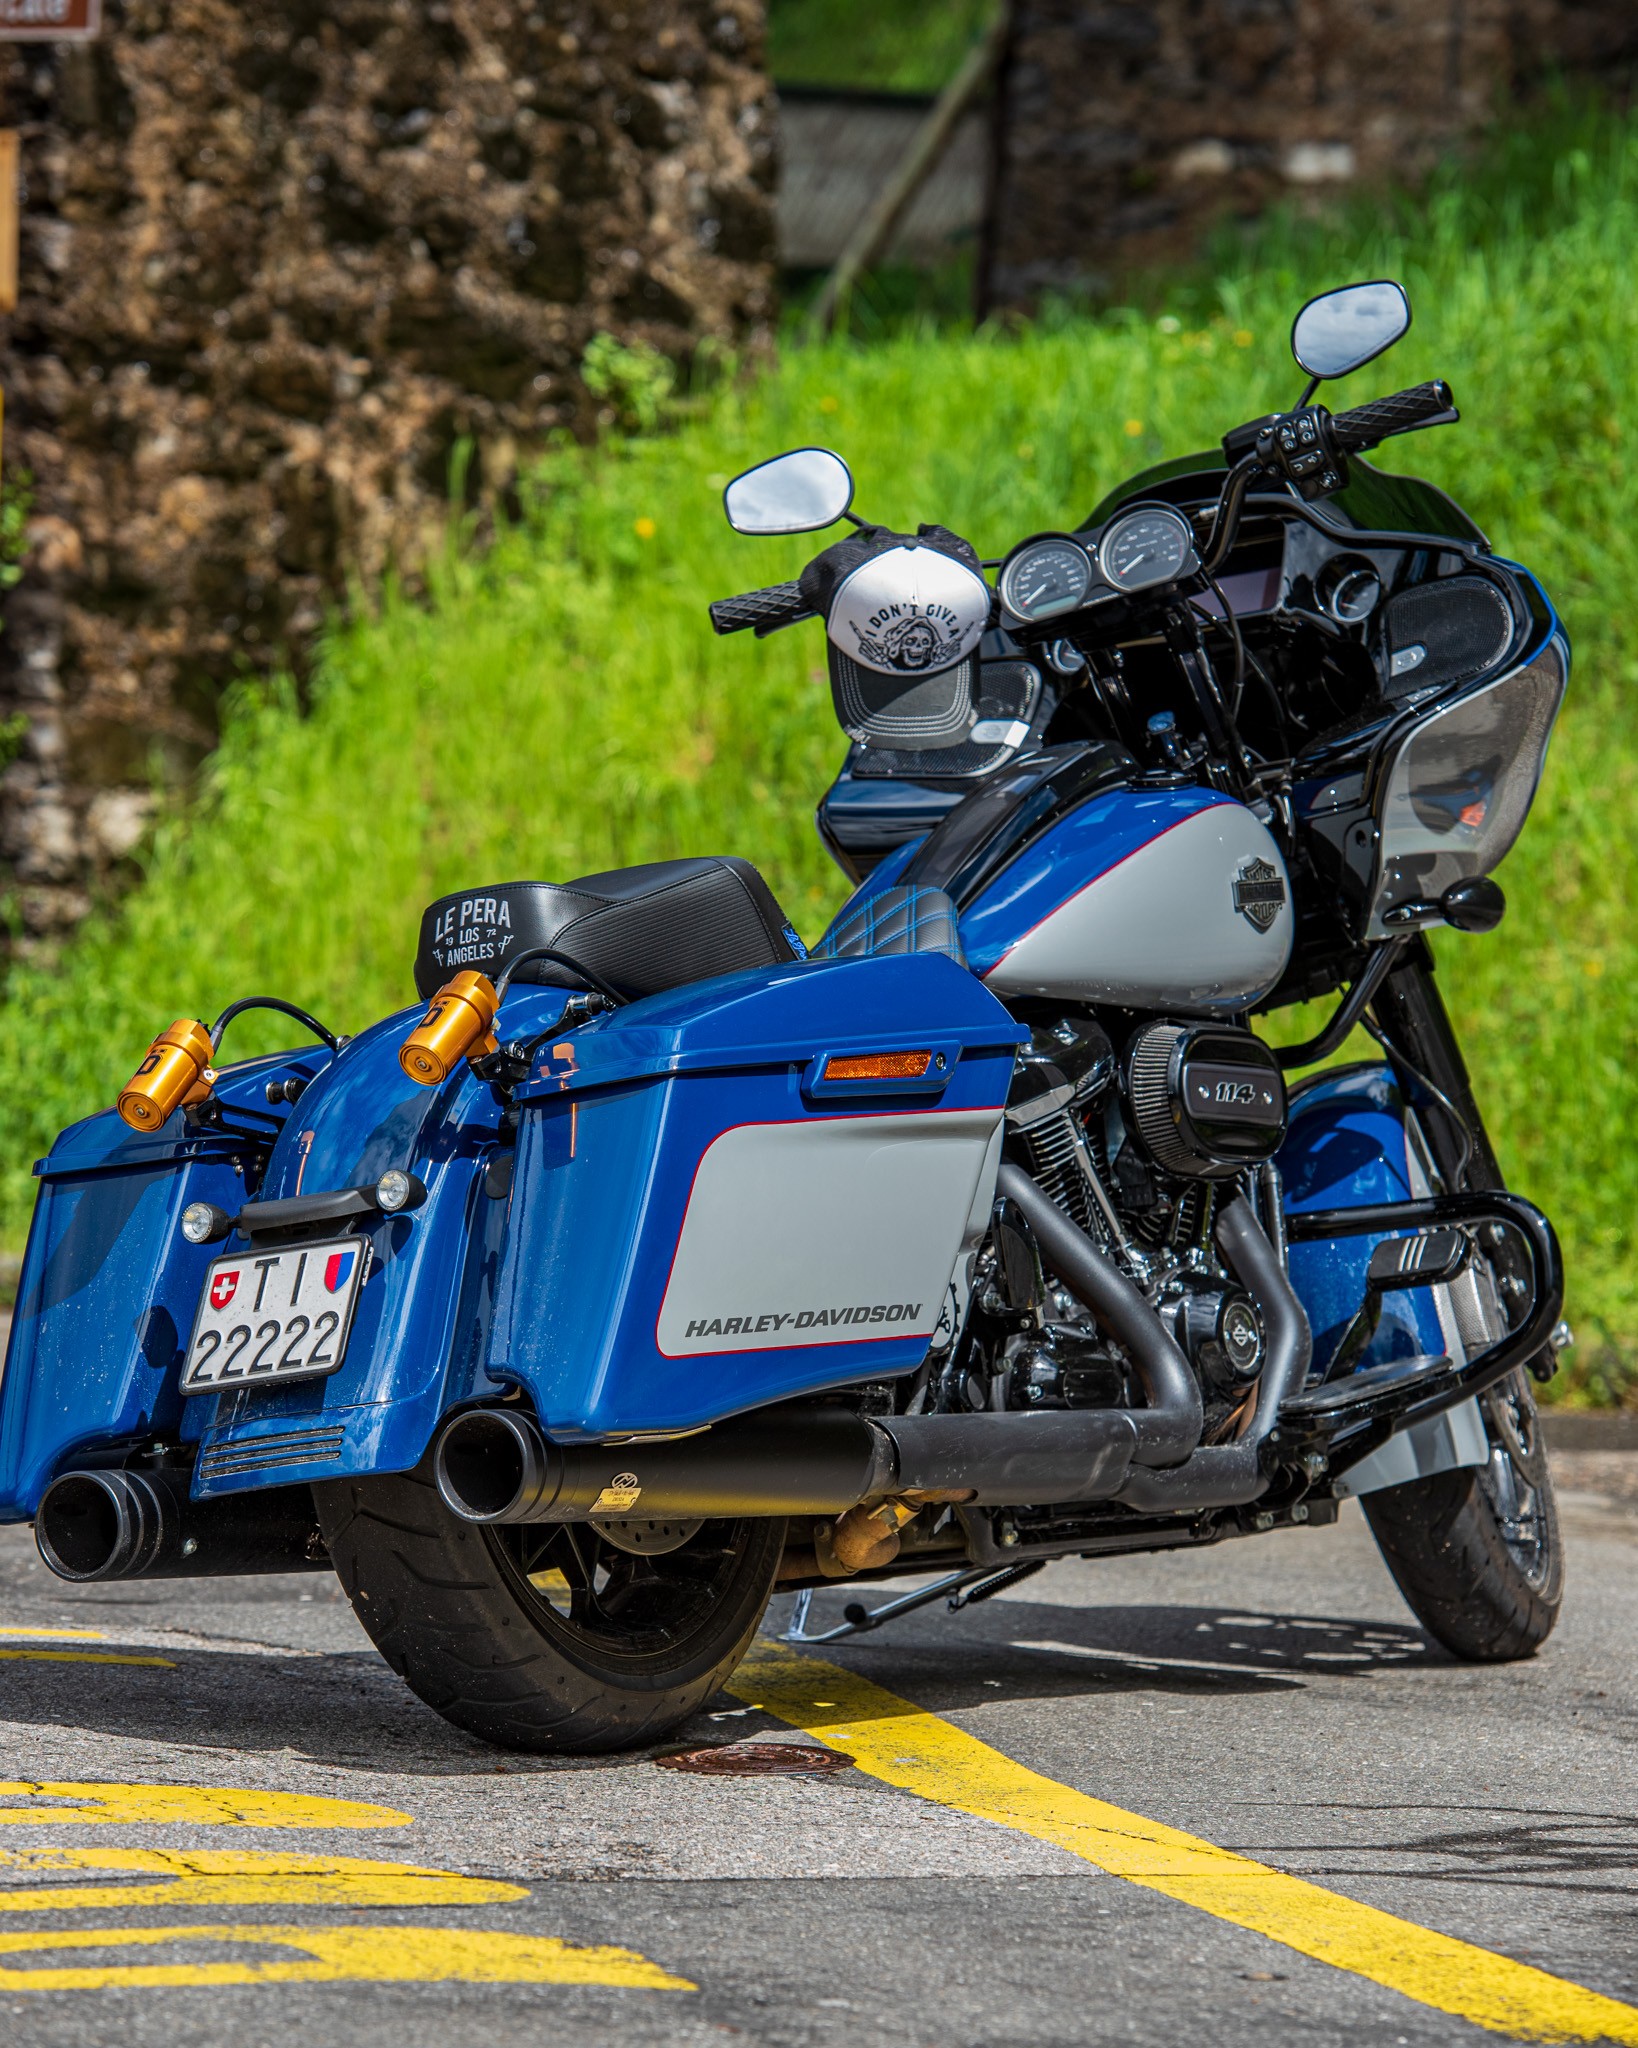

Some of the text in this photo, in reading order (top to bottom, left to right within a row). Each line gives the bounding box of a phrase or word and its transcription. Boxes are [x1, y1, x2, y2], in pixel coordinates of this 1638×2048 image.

[865, 603, 960, 639] I DON'T GIVE A
[434, 898, 511, 943] LE PERA
[459, 926, 480, 945] LOS
[486, 928, 497, 938] 72
[446, 942, 495, 968] ANGELES
[1215, 1081, 1256, 1104] 114
[684, 1303, 922, 1338] HARLEY-DAVIDSON
[188, 1310, 340, 1384] 22222
